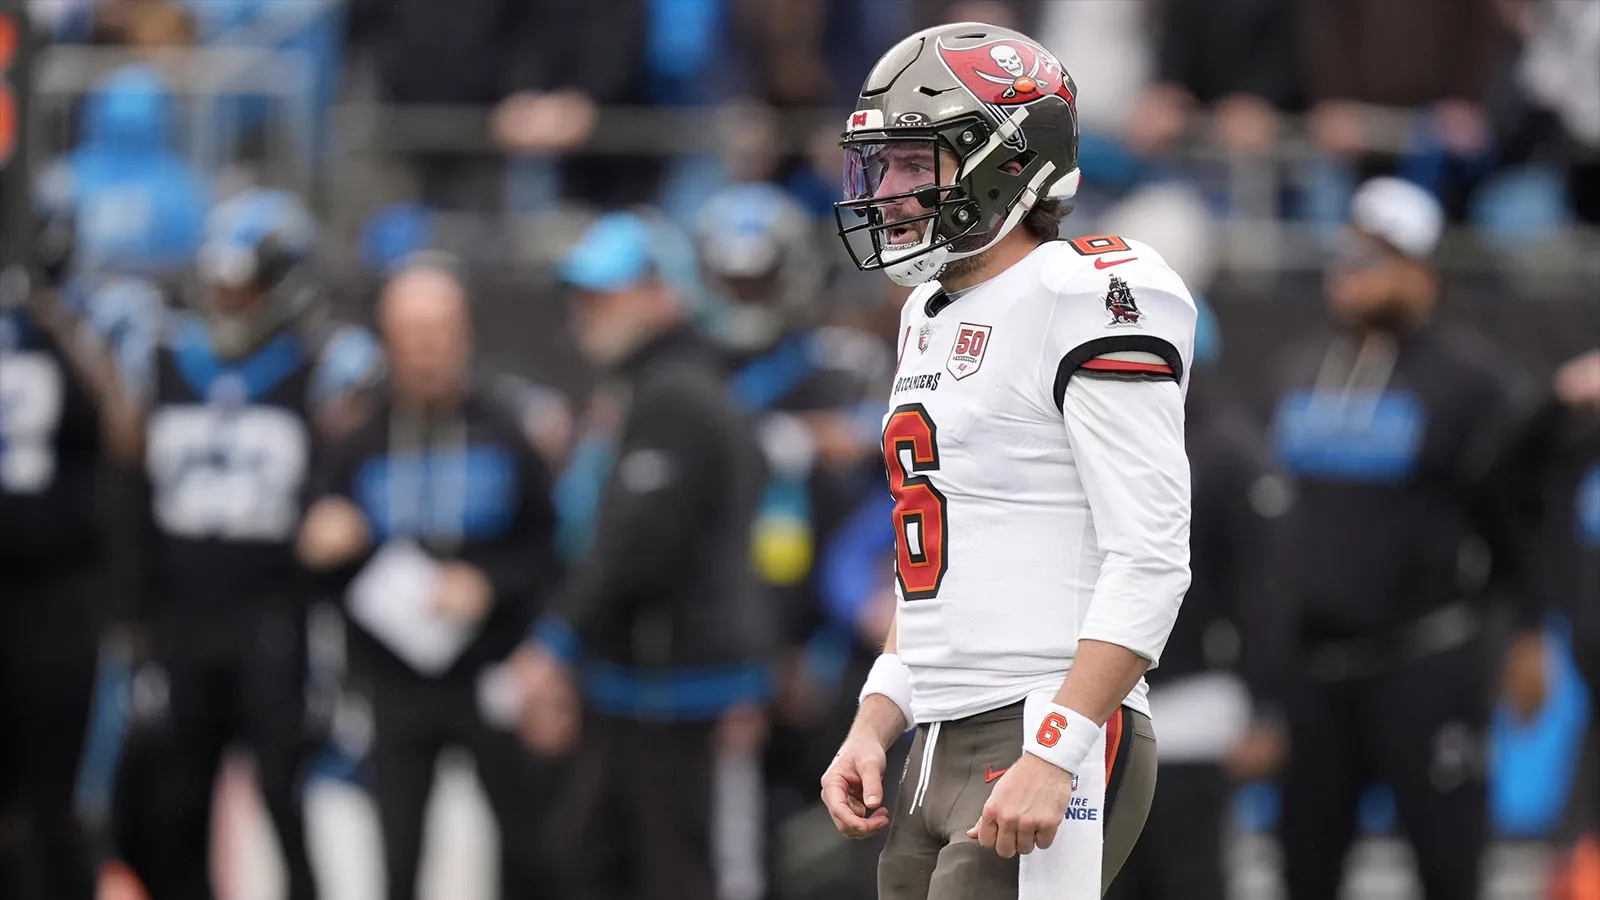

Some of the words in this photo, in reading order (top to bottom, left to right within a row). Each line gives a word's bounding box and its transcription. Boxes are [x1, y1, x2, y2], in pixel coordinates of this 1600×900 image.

[955, 328, 986, 357] 50
[881, 402, 949, 602] 6
[1036, 711, 1068, 749] 6
[1065, 806, 1098, 821] NGE
